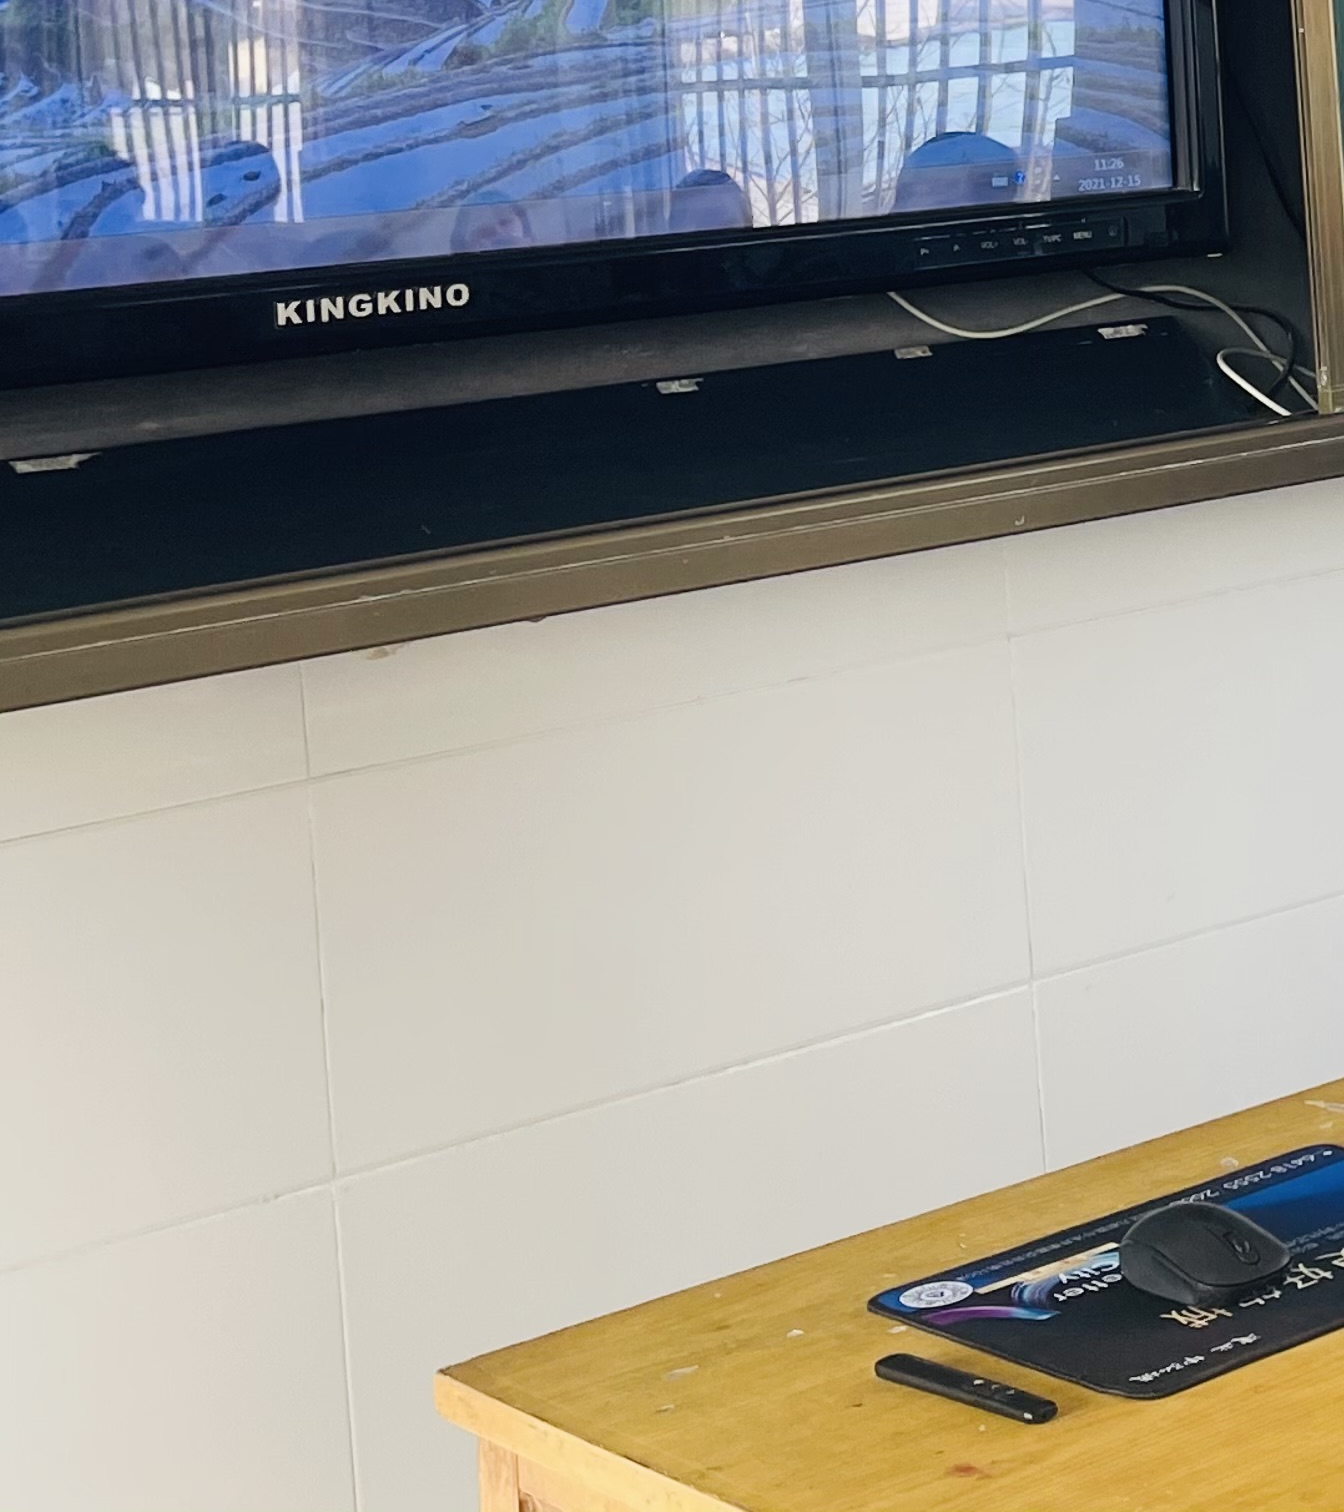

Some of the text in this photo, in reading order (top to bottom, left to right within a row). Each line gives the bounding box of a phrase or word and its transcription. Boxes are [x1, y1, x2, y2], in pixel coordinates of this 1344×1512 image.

[1094, 157, 1125, 171] 11:26
[1078, 174, 1142, 191] 2021-12-15
[276, 283, 470, 326] KINGKINO
[1059, 1260, 1120, 1284] City
[1053, 1273, 1124, 1302] etter
